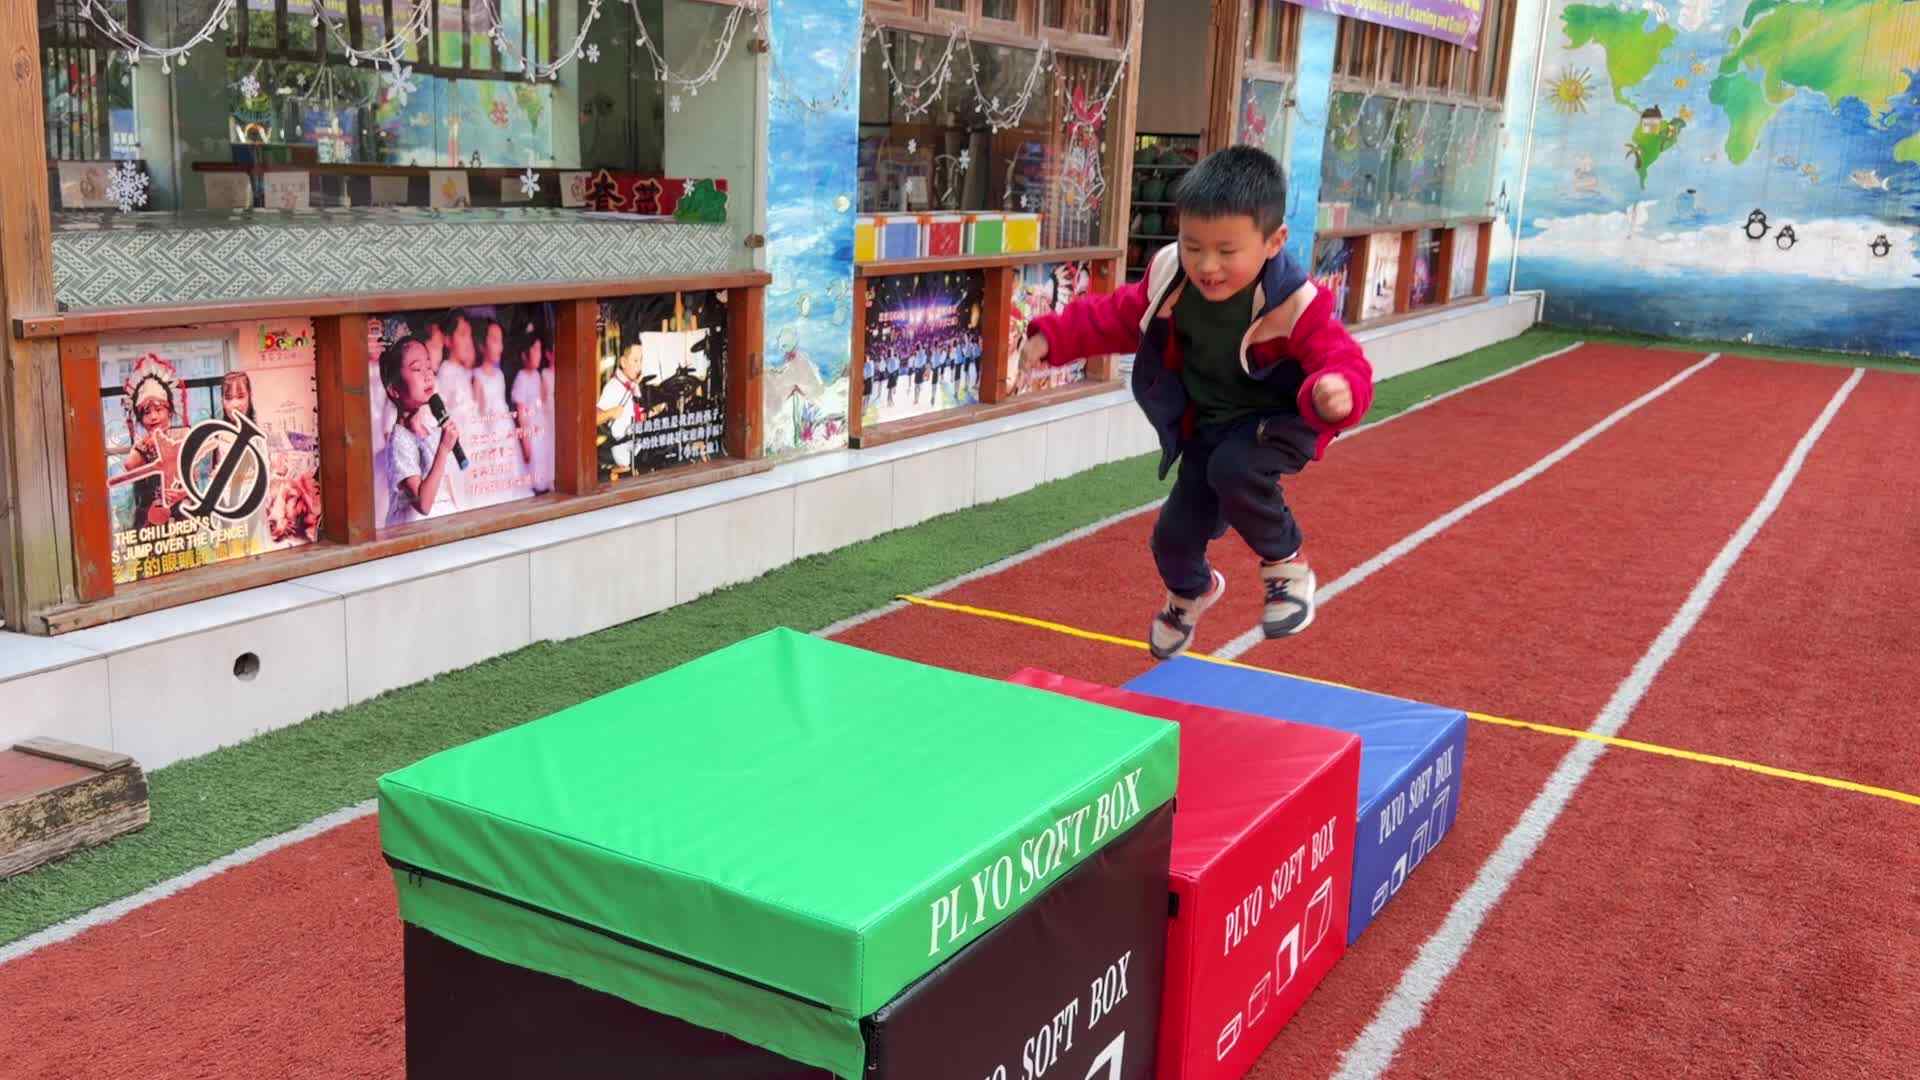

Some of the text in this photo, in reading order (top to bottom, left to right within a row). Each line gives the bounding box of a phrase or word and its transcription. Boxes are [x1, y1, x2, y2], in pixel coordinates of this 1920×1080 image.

[113, 530, 138, 546] THE
[123, 545, 152, 561] JUMP
[154, 537, 185, 555] OVER
[187, 531, 211, 550] THE
[1379, 745, 1454, 845] PLYO SOFT BOX
[928, 768, 1142, 957] PLYO SOFT BOX
[1224, 816, 1337, 956] PLYO SOFT BOX
[1021, 950, 1131, 1080] SOFT BOX
